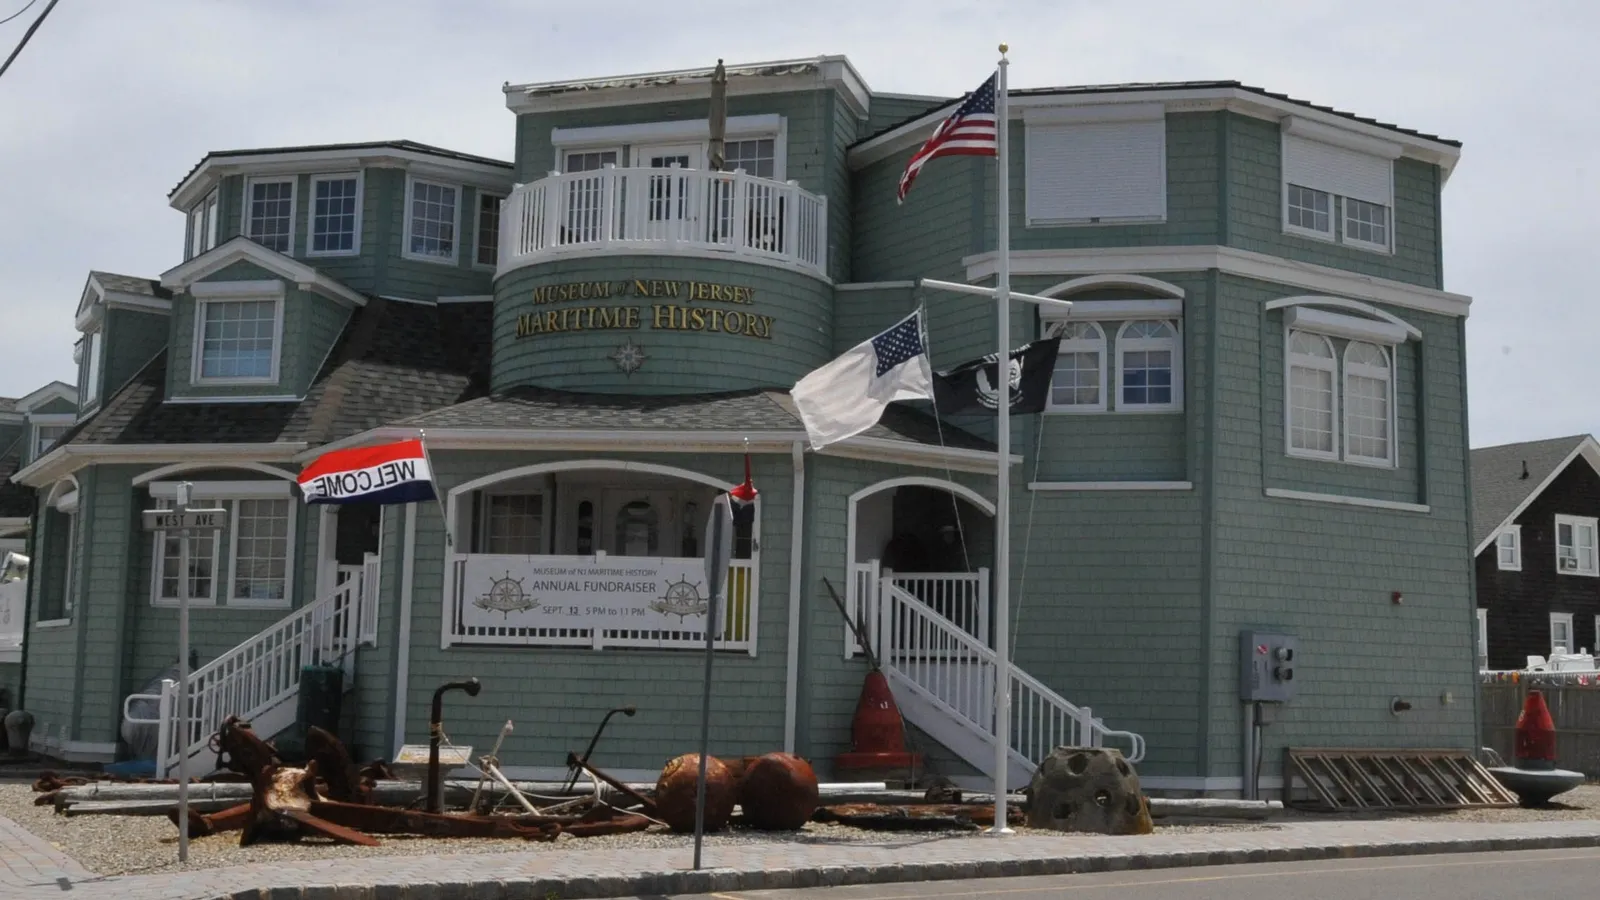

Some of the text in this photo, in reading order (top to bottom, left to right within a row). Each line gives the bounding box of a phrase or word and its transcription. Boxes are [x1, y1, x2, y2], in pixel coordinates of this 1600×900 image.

[532, 280, 756, 305] MUSEUM of NEW JERSEY
[515, 304, 777, 340] MARITIME HISTORY
[156, 514, 214, 527] WEST AVE
[533, 568, 567, 576] MUSEUM
[588, 569, 624, 577] MARITIME
[532, 581, 656, 593] ANNUAL FUNDRAISER
[585, 607, 591, 615] 5
[593, 607, 606, 615] PM
[608, 607, 618, 616] to
[620, 607, 629, 615] 11
[631, 607, 645, 616] PM
